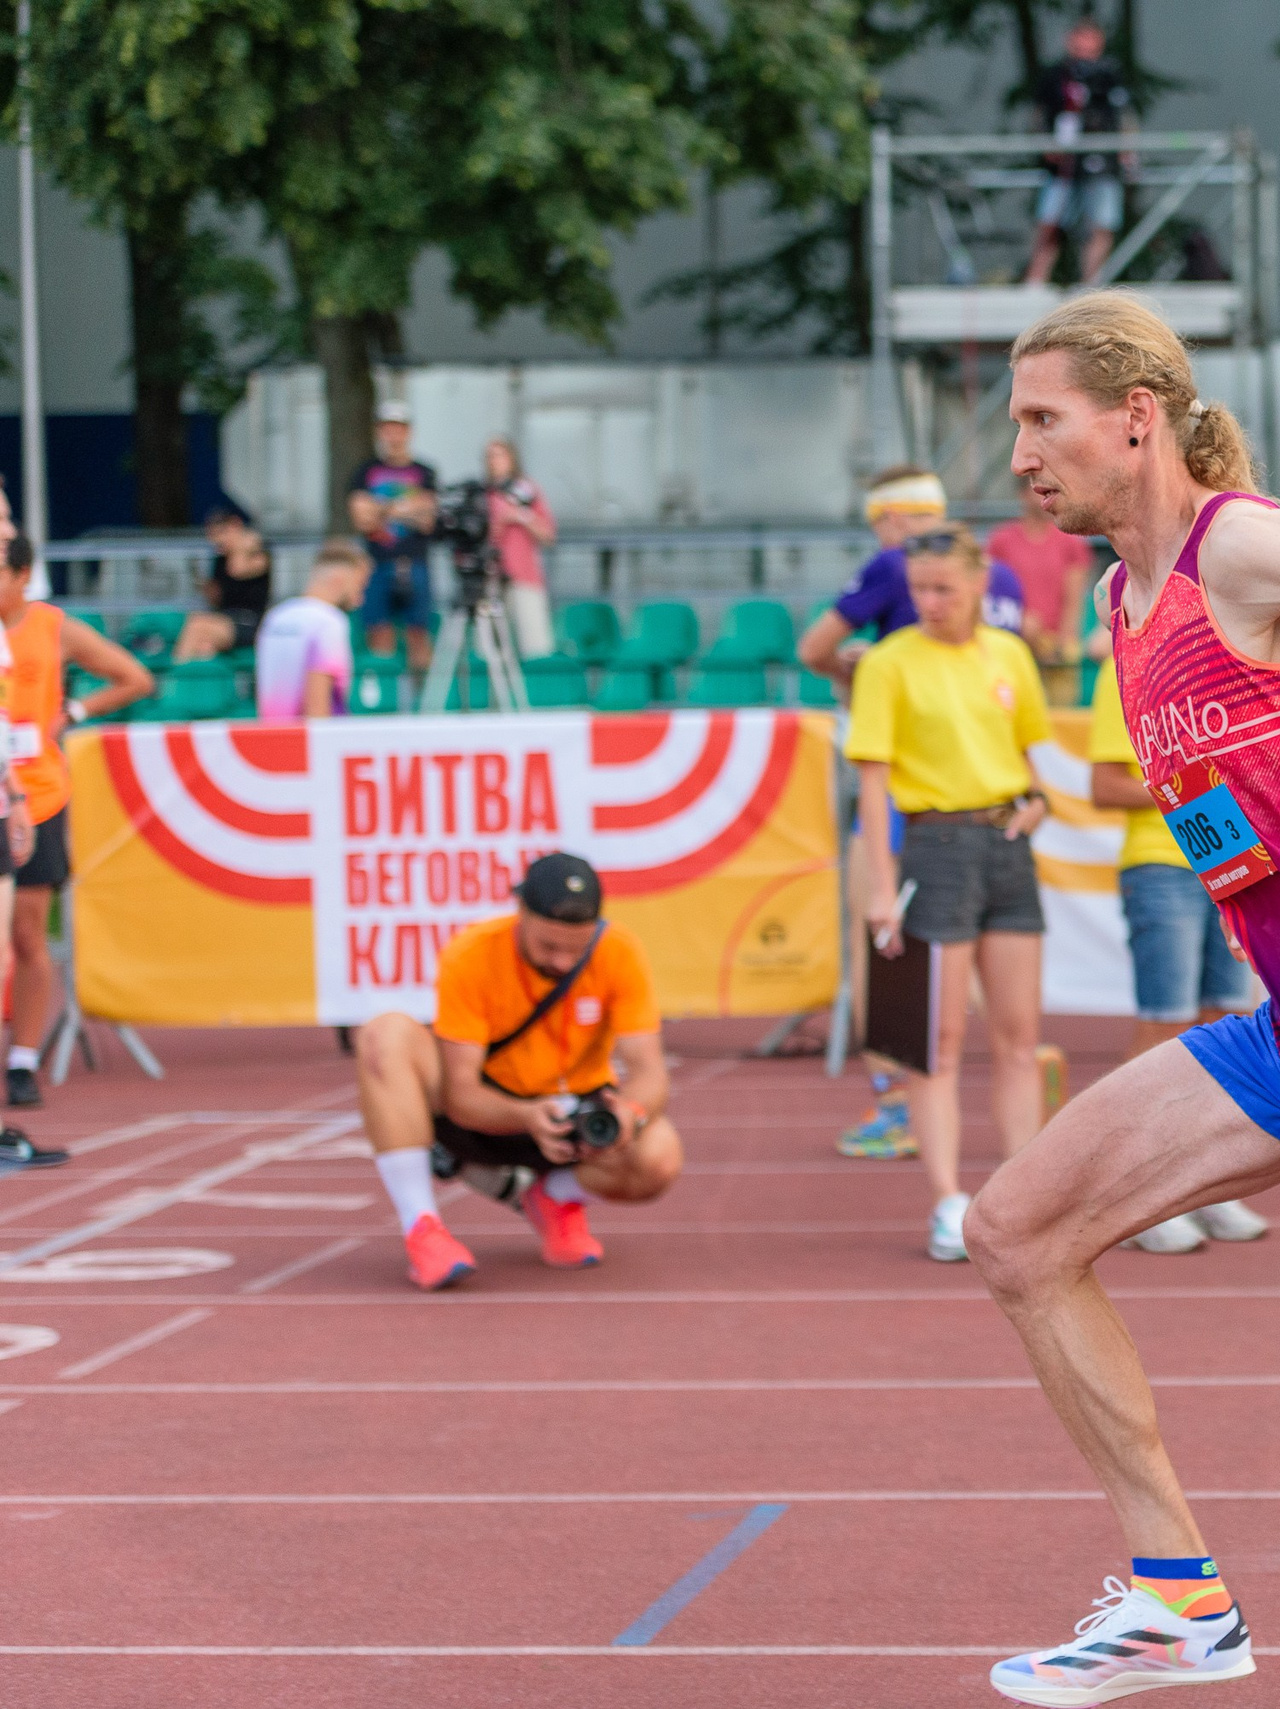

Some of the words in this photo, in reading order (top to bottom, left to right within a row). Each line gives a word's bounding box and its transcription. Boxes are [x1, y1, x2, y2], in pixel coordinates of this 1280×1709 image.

[343, 752, 559, 837] БИТВА
[1176, 812, 1223, 860] 206
[1225, 819, 1241, 840] 3
